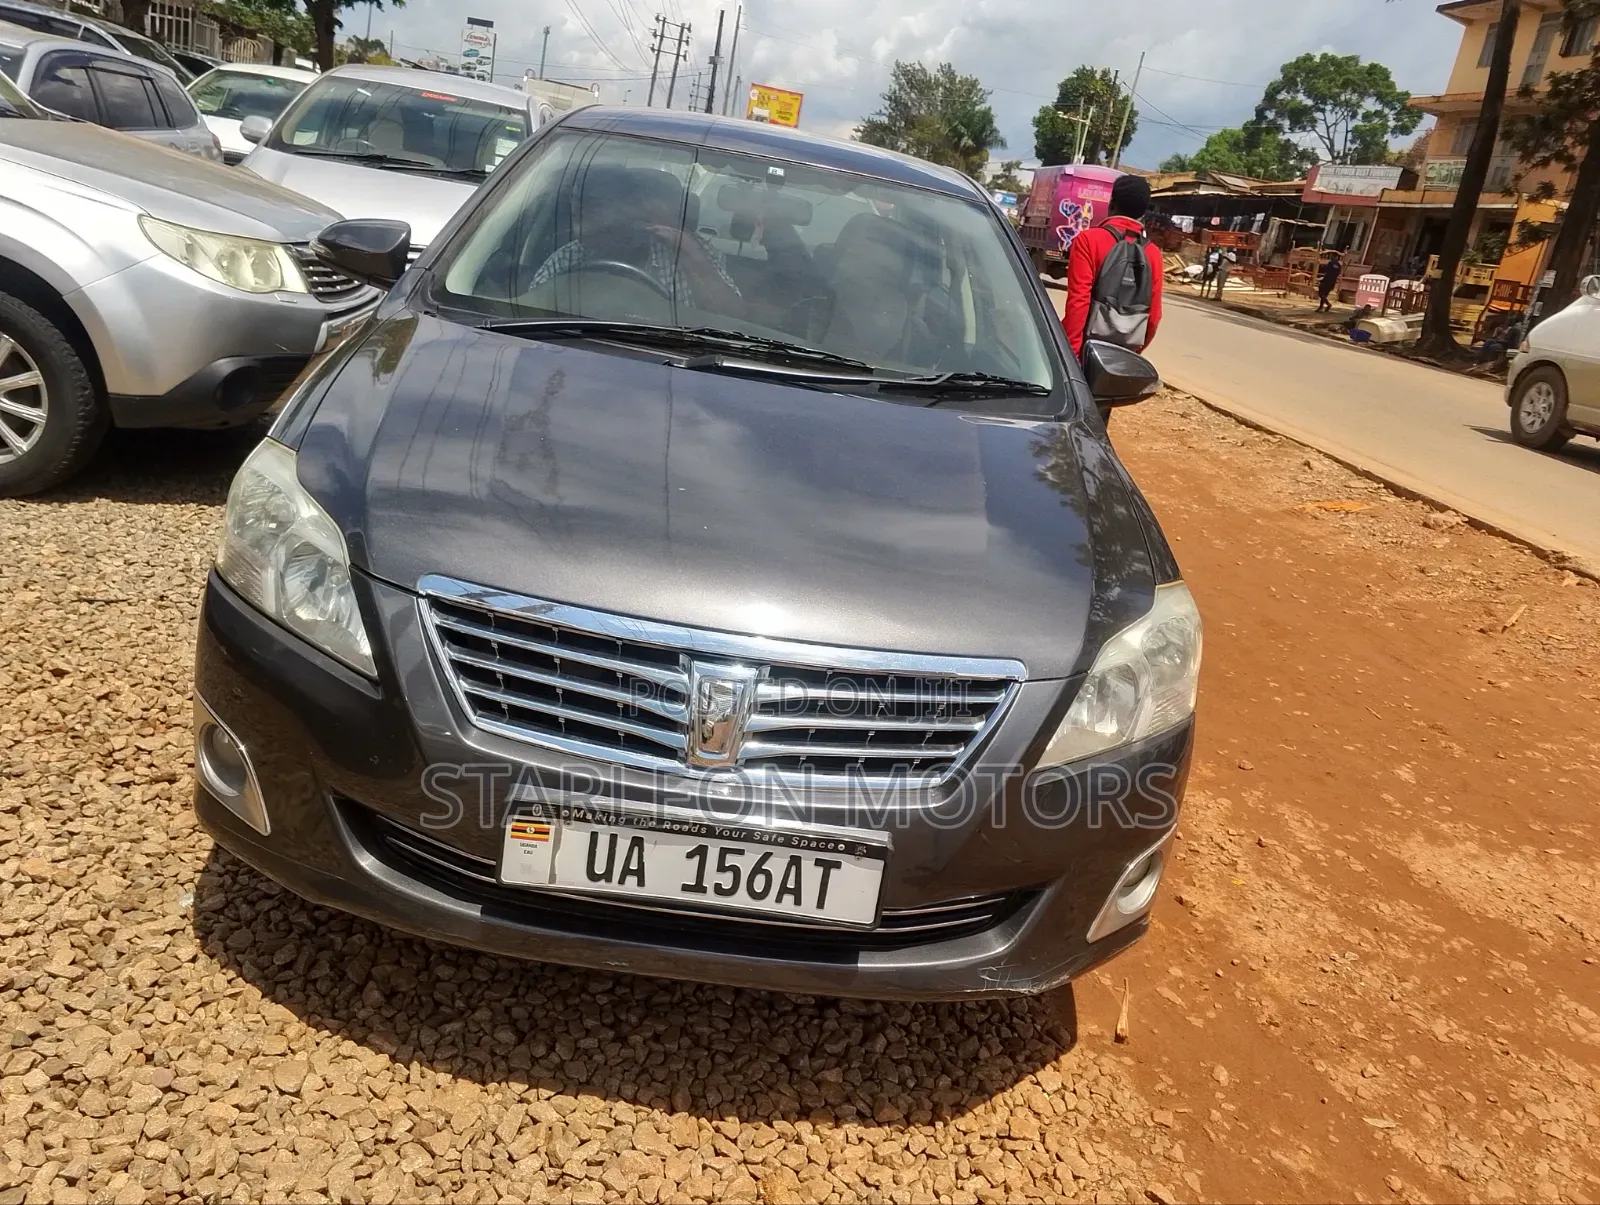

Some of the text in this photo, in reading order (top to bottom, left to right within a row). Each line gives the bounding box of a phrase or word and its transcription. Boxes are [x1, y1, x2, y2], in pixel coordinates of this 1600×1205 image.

[572, 808, 626, 826] Making
[632, 816, 657, 829] the
[662, 820, 707, 834] Roads
[714, 826, 747, 839] Your
[753, 831, 785, 844] Safe
[791, 836, 835, 850] Space
[585, 830, 842, 910] UA 156AT
